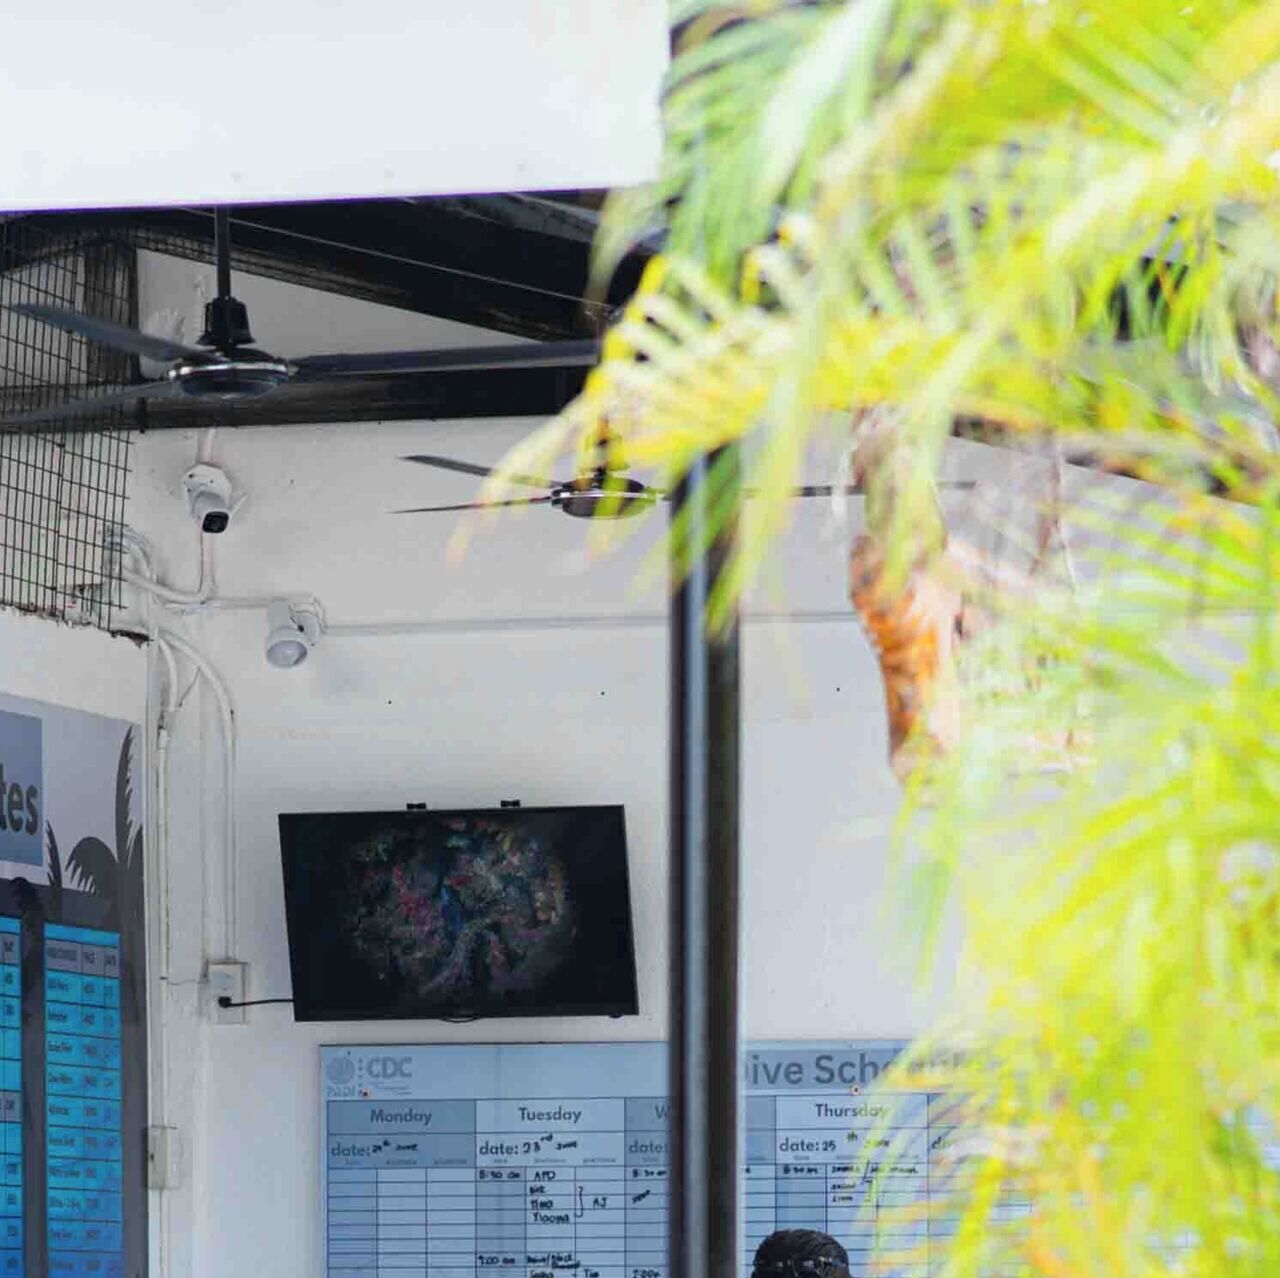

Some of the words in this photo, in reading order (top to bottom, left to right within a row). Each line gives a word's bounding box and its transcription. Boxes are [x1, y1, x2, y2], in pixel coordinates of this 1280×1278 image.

[366, 1056, 413, 1079] CDC
[745, 1053, 803, 1086] ive
[370, 1108, 432, 1126] Monday
[518, 1105, 581, 1124] Tuesday
[816, 1103, 888, 1120] Thursday
[331, 1142, 370, 1157] date:
[480, 1140, 519, 1156] date:
[779, 1137, 819, 1152] date:
